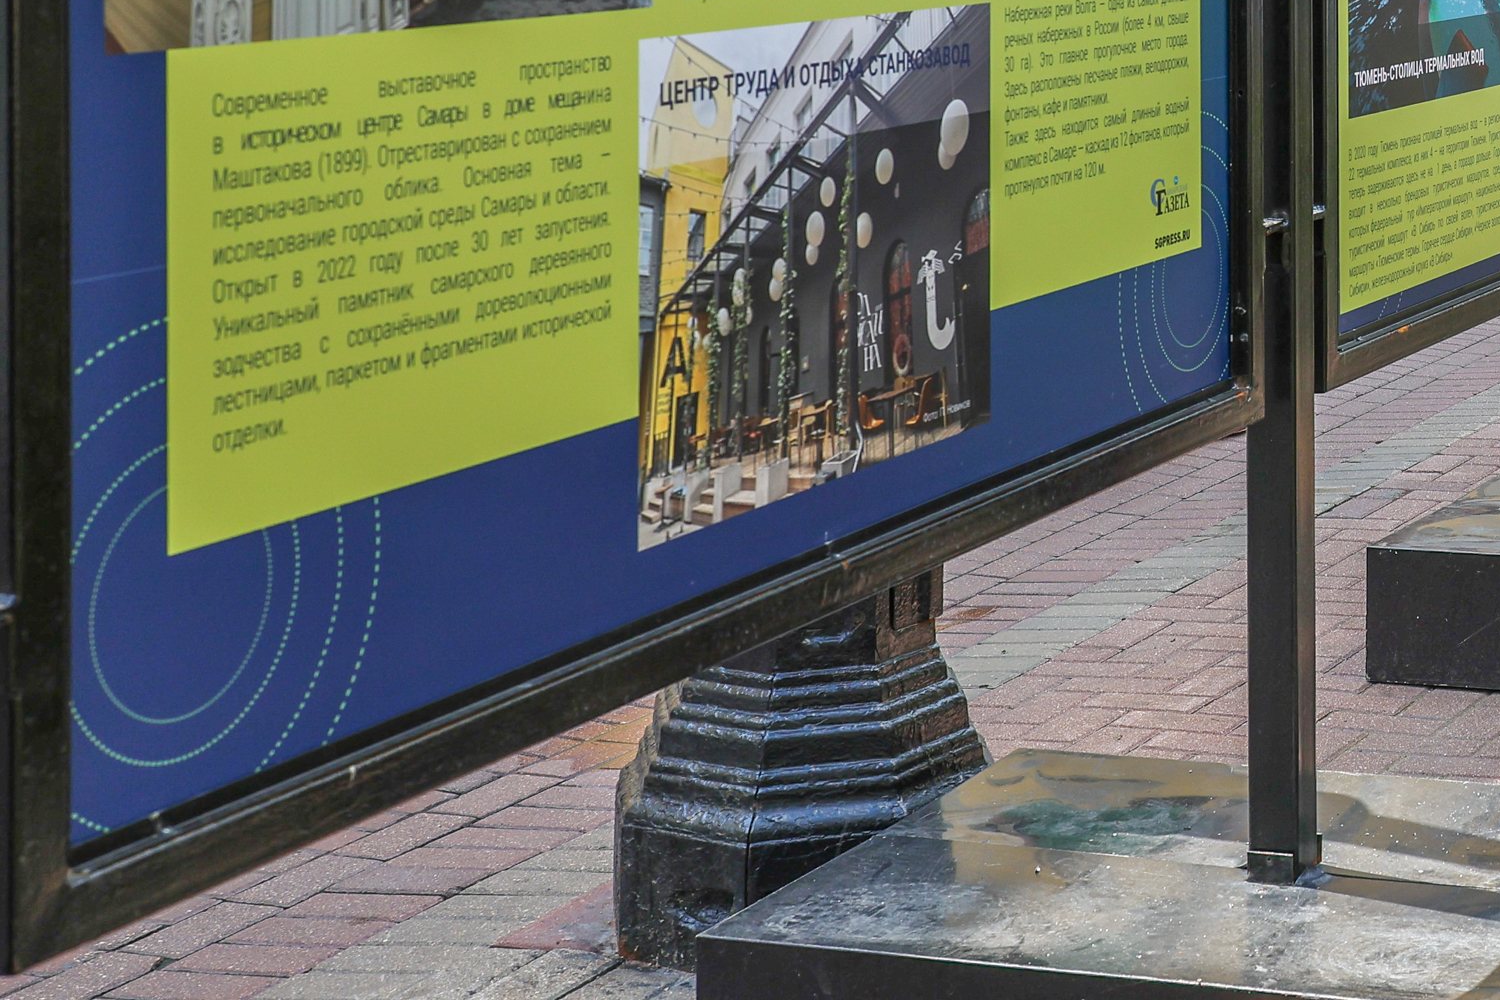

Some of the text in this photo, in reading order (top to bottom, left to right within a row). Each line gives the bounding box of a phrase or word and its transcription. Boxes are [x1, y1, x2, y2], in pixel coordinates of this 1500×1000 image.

[211, 55, 613, 120] Современное выставочное пространство
[660, 43, 971, 107] ЦЕНТР ТРУДА И ОТДЫХА СТАНКОЗАВОД
[1354, 48, 1485, 88] ТЮМЕНЬ-СТОЛИЦА ТЕРМАЛЬНЫХ ВОД
[212, 160, 313, 191] Маштакова
[377, 133, 507, 170] Отреставрирован
[511, 130, 520, 148] с
[524, 117, 612, 147] сохранением
[212, 187, 364, 232] первоначального
[463, 161, 532, 189] Основная
[549, 153, 583, 173] тема
[212, 227, 337, 266] исследование
[342, 207, 424, 246] городской
[428, 204, 476, 231] среды
[480, 193, 537, 219] Самары
[542, 190, 551, 207] и
[1155, 189, 1190, 216] ГАЗЕТА
[212, 273, 278, 304] Открыт
[292, 269, 304, 289] в
[316, 254, 357, 284] 2022
[369, 251, 404, 275] году
[415, 239, 460, 264] после
[471, 229, 489, 254] 30
[500, 227, 524, 247] лет
[1155, 228, 1191, 250] SGPRESS.RU
[212, 242, 612, 341] Уникальный памятник самарского деревянного
[212, 273, 612, 379] зодчества с сохранёнными дореволюционными
[326, 354, 402, 389] паркетом
[405, 351, 416, 369] и
[420, 326, 518, 370] фрагментами
[522, 299, 612, 340] исторической
